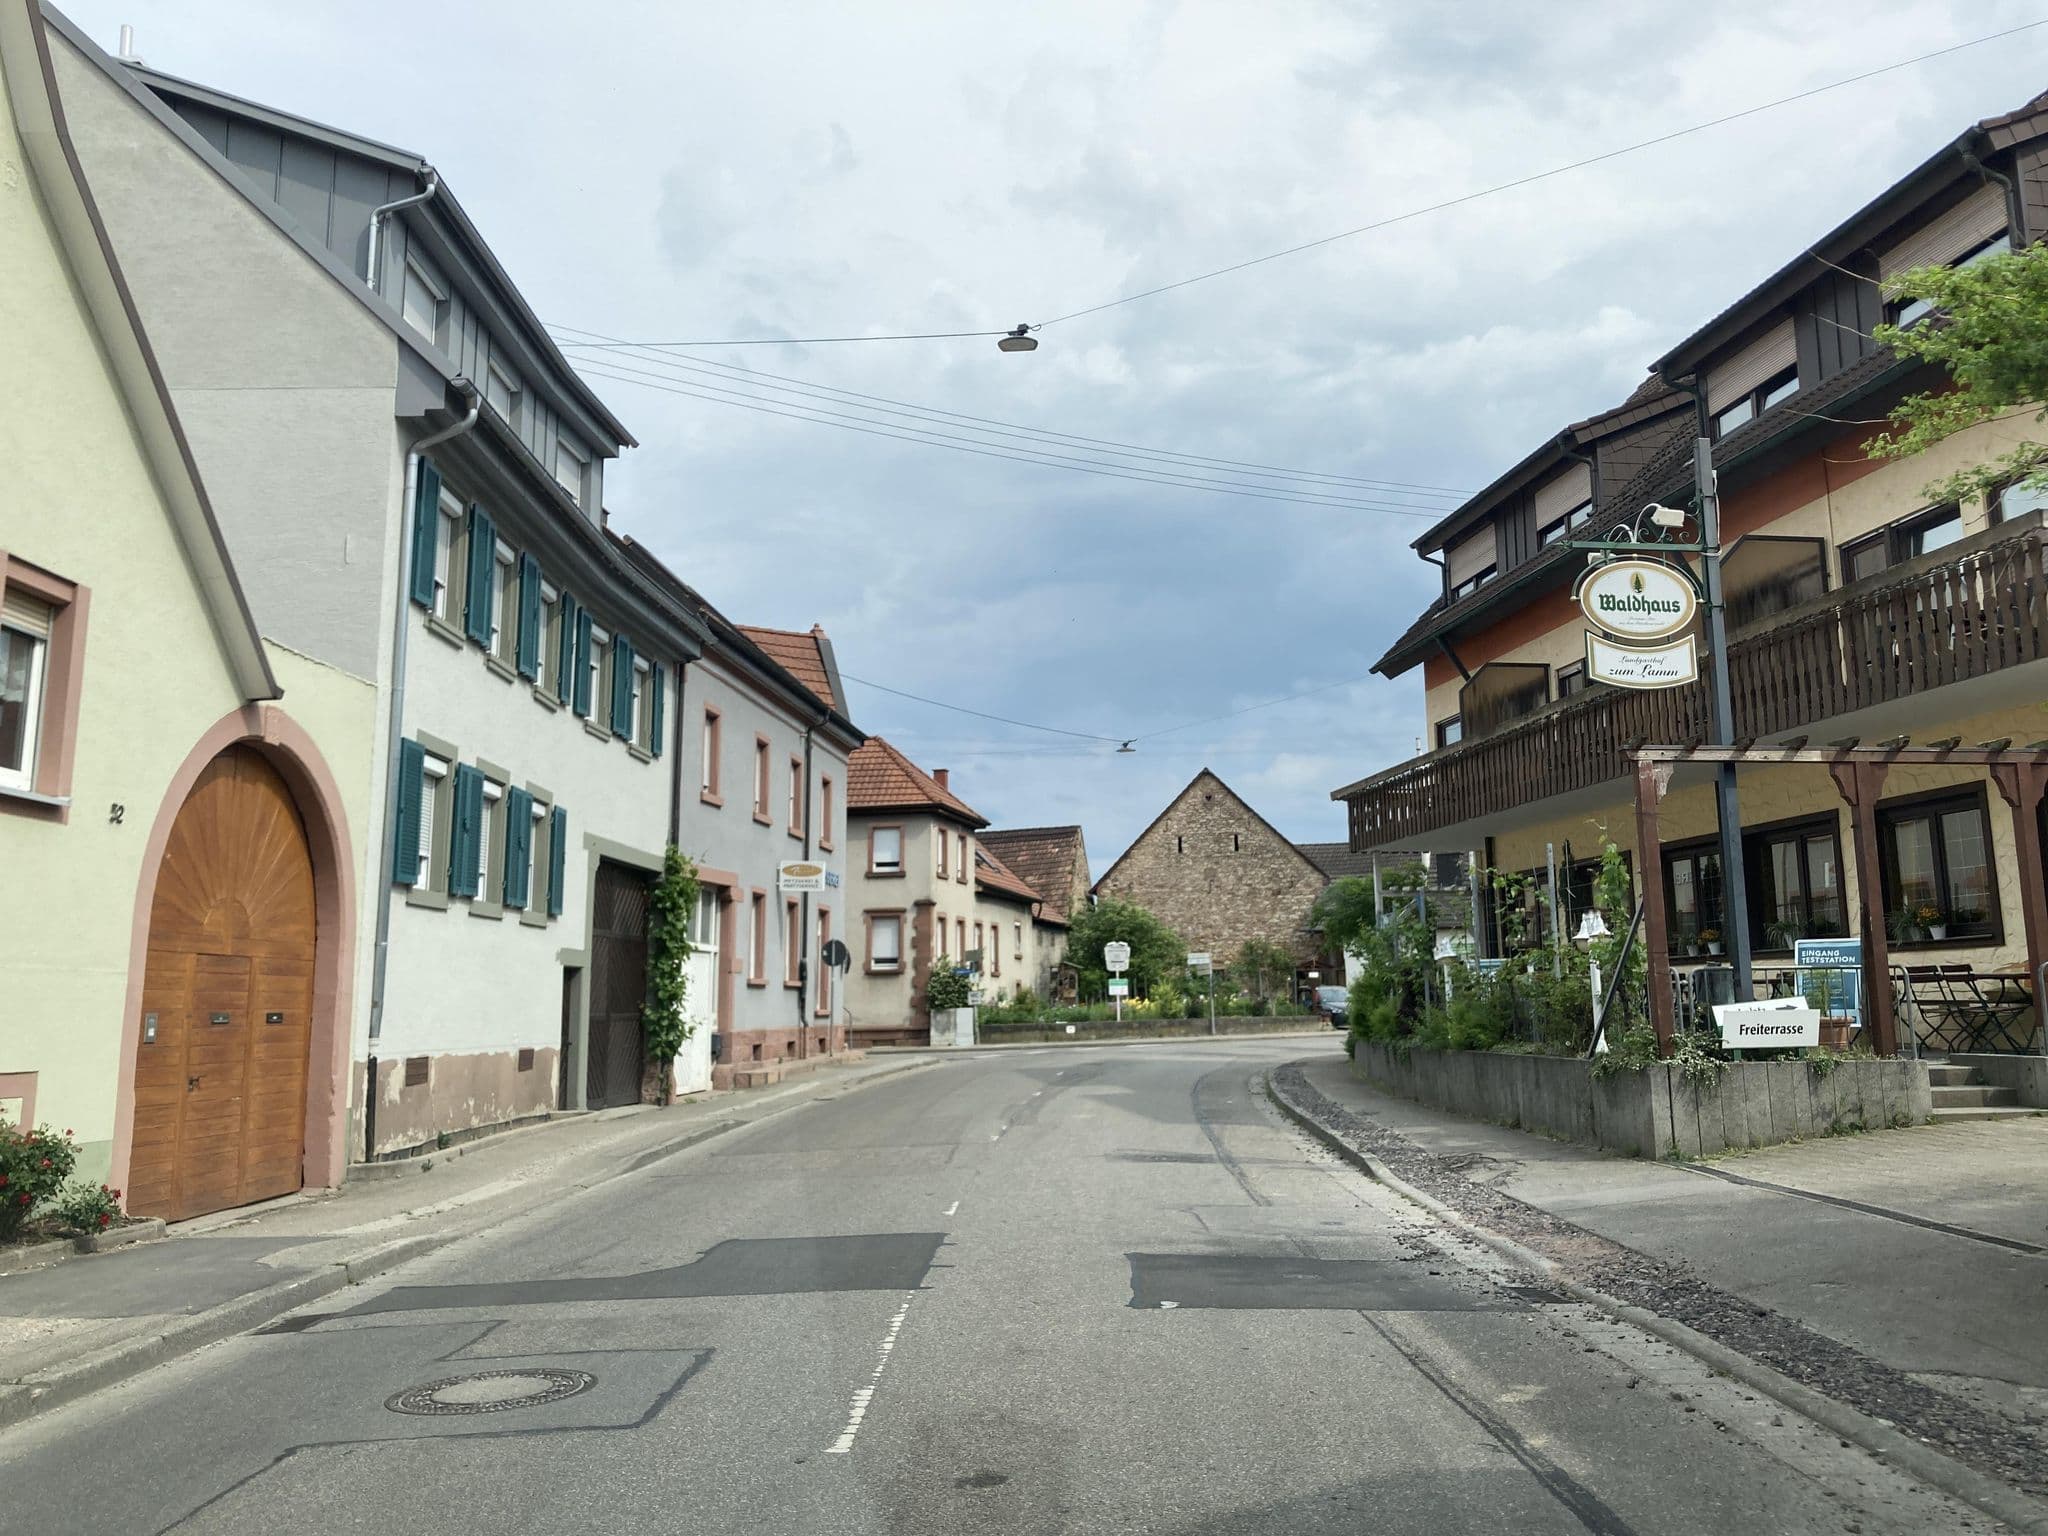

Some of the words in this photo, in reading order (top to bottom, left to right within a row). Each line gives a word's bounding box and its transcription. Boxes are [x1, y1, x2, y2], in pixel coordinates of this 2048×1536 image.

[1598, 593, 1681, 615] Waldhaus
[1638, 664, 1678, 678] Lamm
[1801, 949, 1840, 957] EINGANG
[1801, 956, 1856, 964] TESTSTATION
[1739, 1023, 1804, 1036] Freiterrasse
